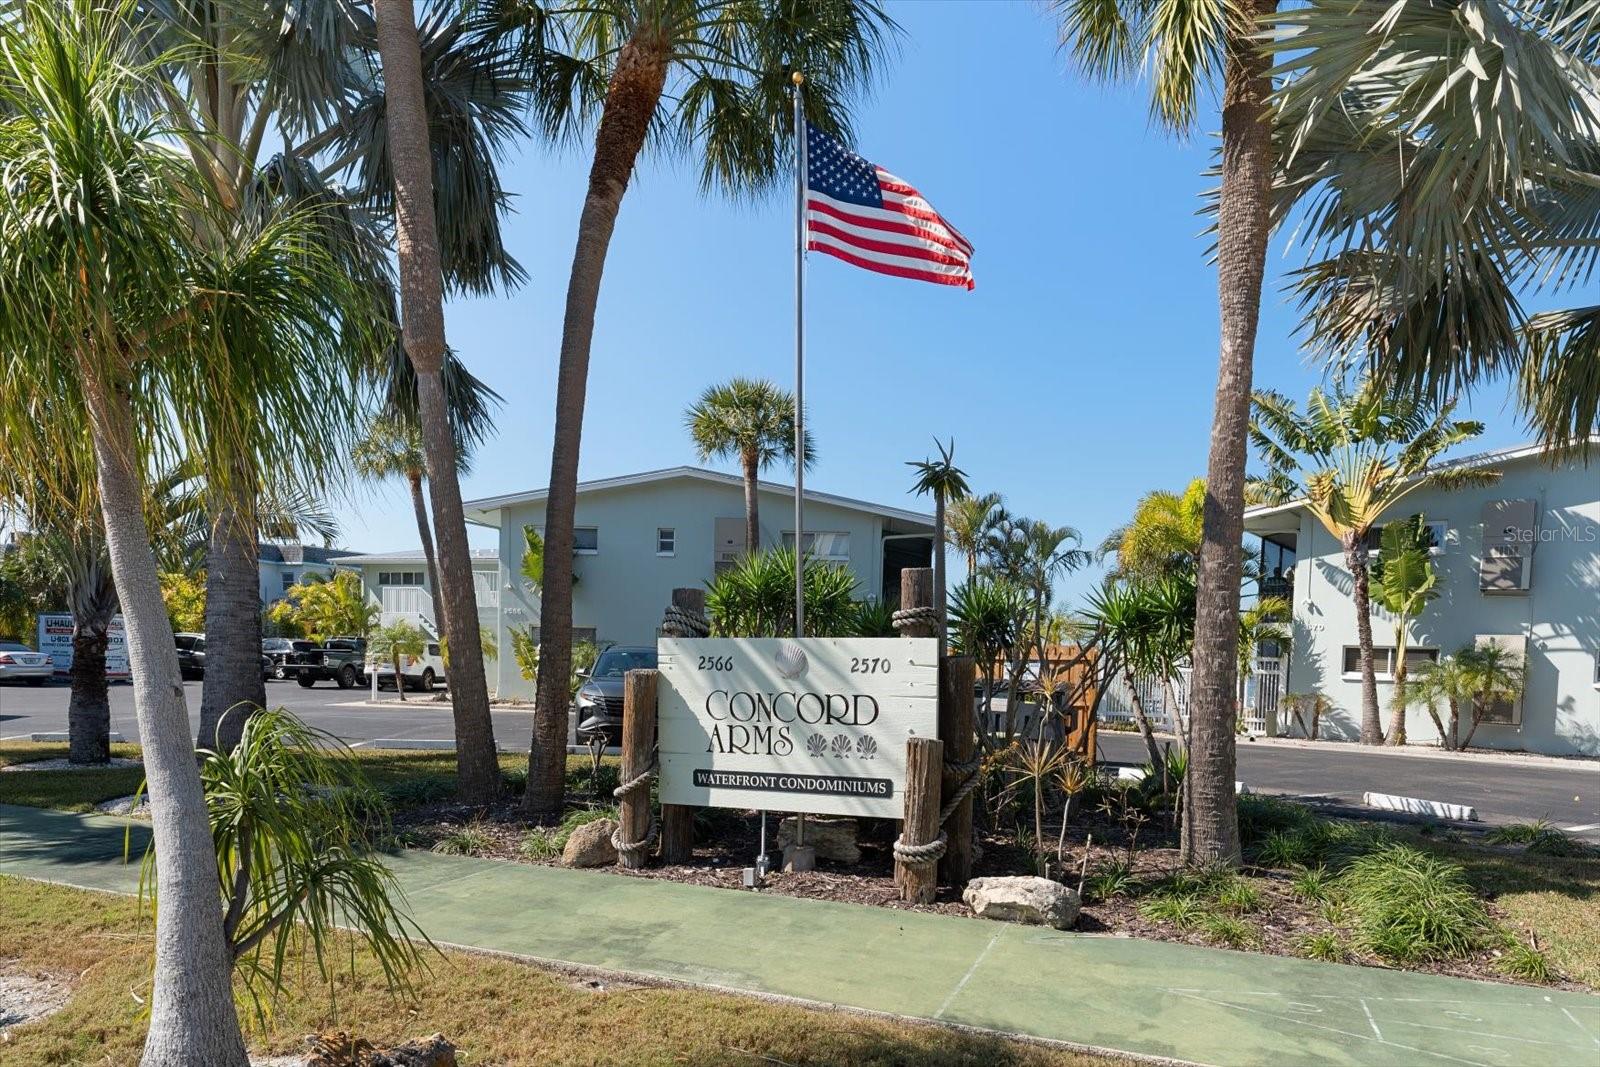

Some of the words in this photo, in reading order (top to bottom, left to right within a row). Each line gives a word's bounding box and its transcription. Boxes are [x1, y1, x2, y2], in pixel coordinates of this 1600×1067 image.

[698, 656, 733, 672] 2566
[851, 657, 891, 674] 2570
[705, 689, 879, 726] CONCORD
[706, 723, 794, 757] ARMS
[697, 773, 777, 789] WATERFRONT
[779, 779, 886, 794] CONDOMINIUMS
